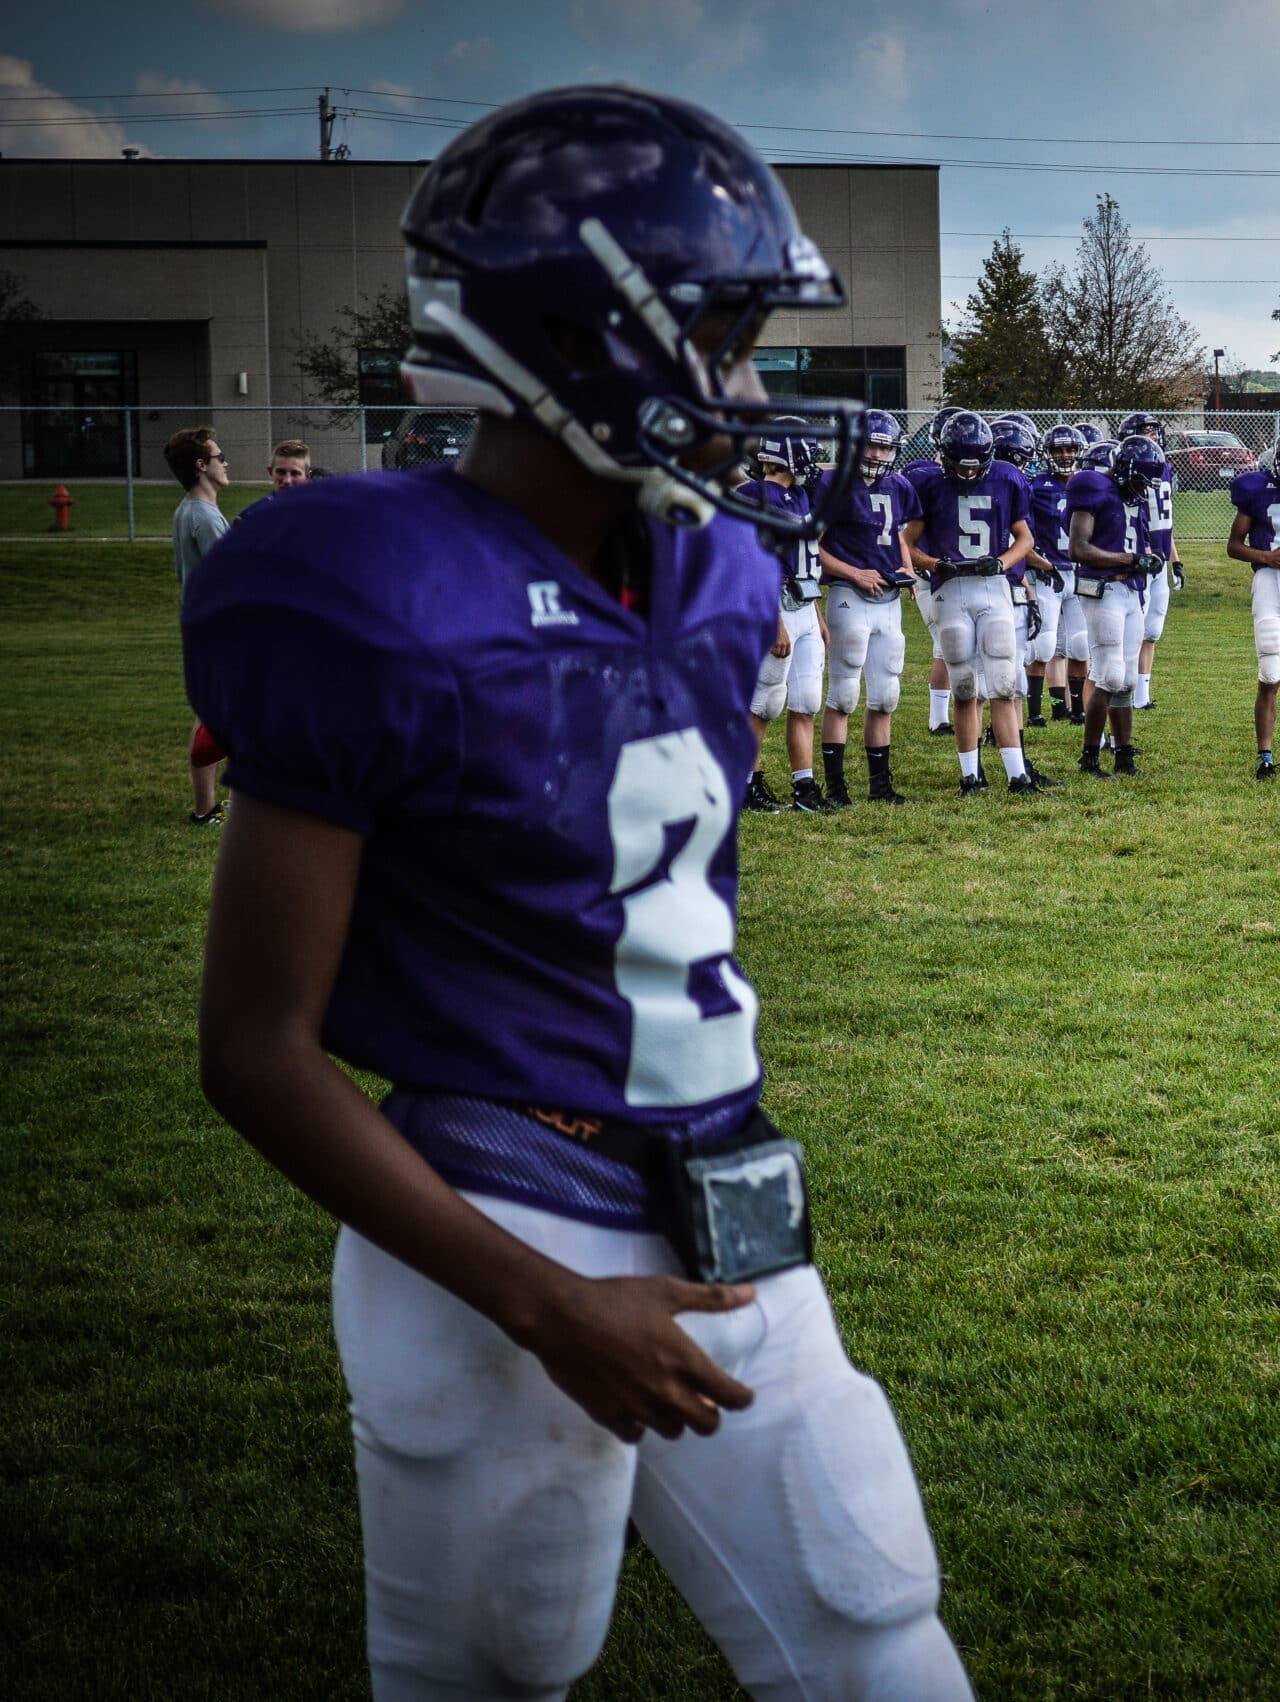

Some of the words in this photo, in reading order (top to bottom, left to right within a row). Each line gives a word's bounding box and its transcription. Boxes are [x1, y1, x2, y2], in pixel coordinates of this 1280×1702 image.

[869, 494, 894, 546] 7
[958, 496, 992, 559] 5
[607, 727, 761, 1106] 2
